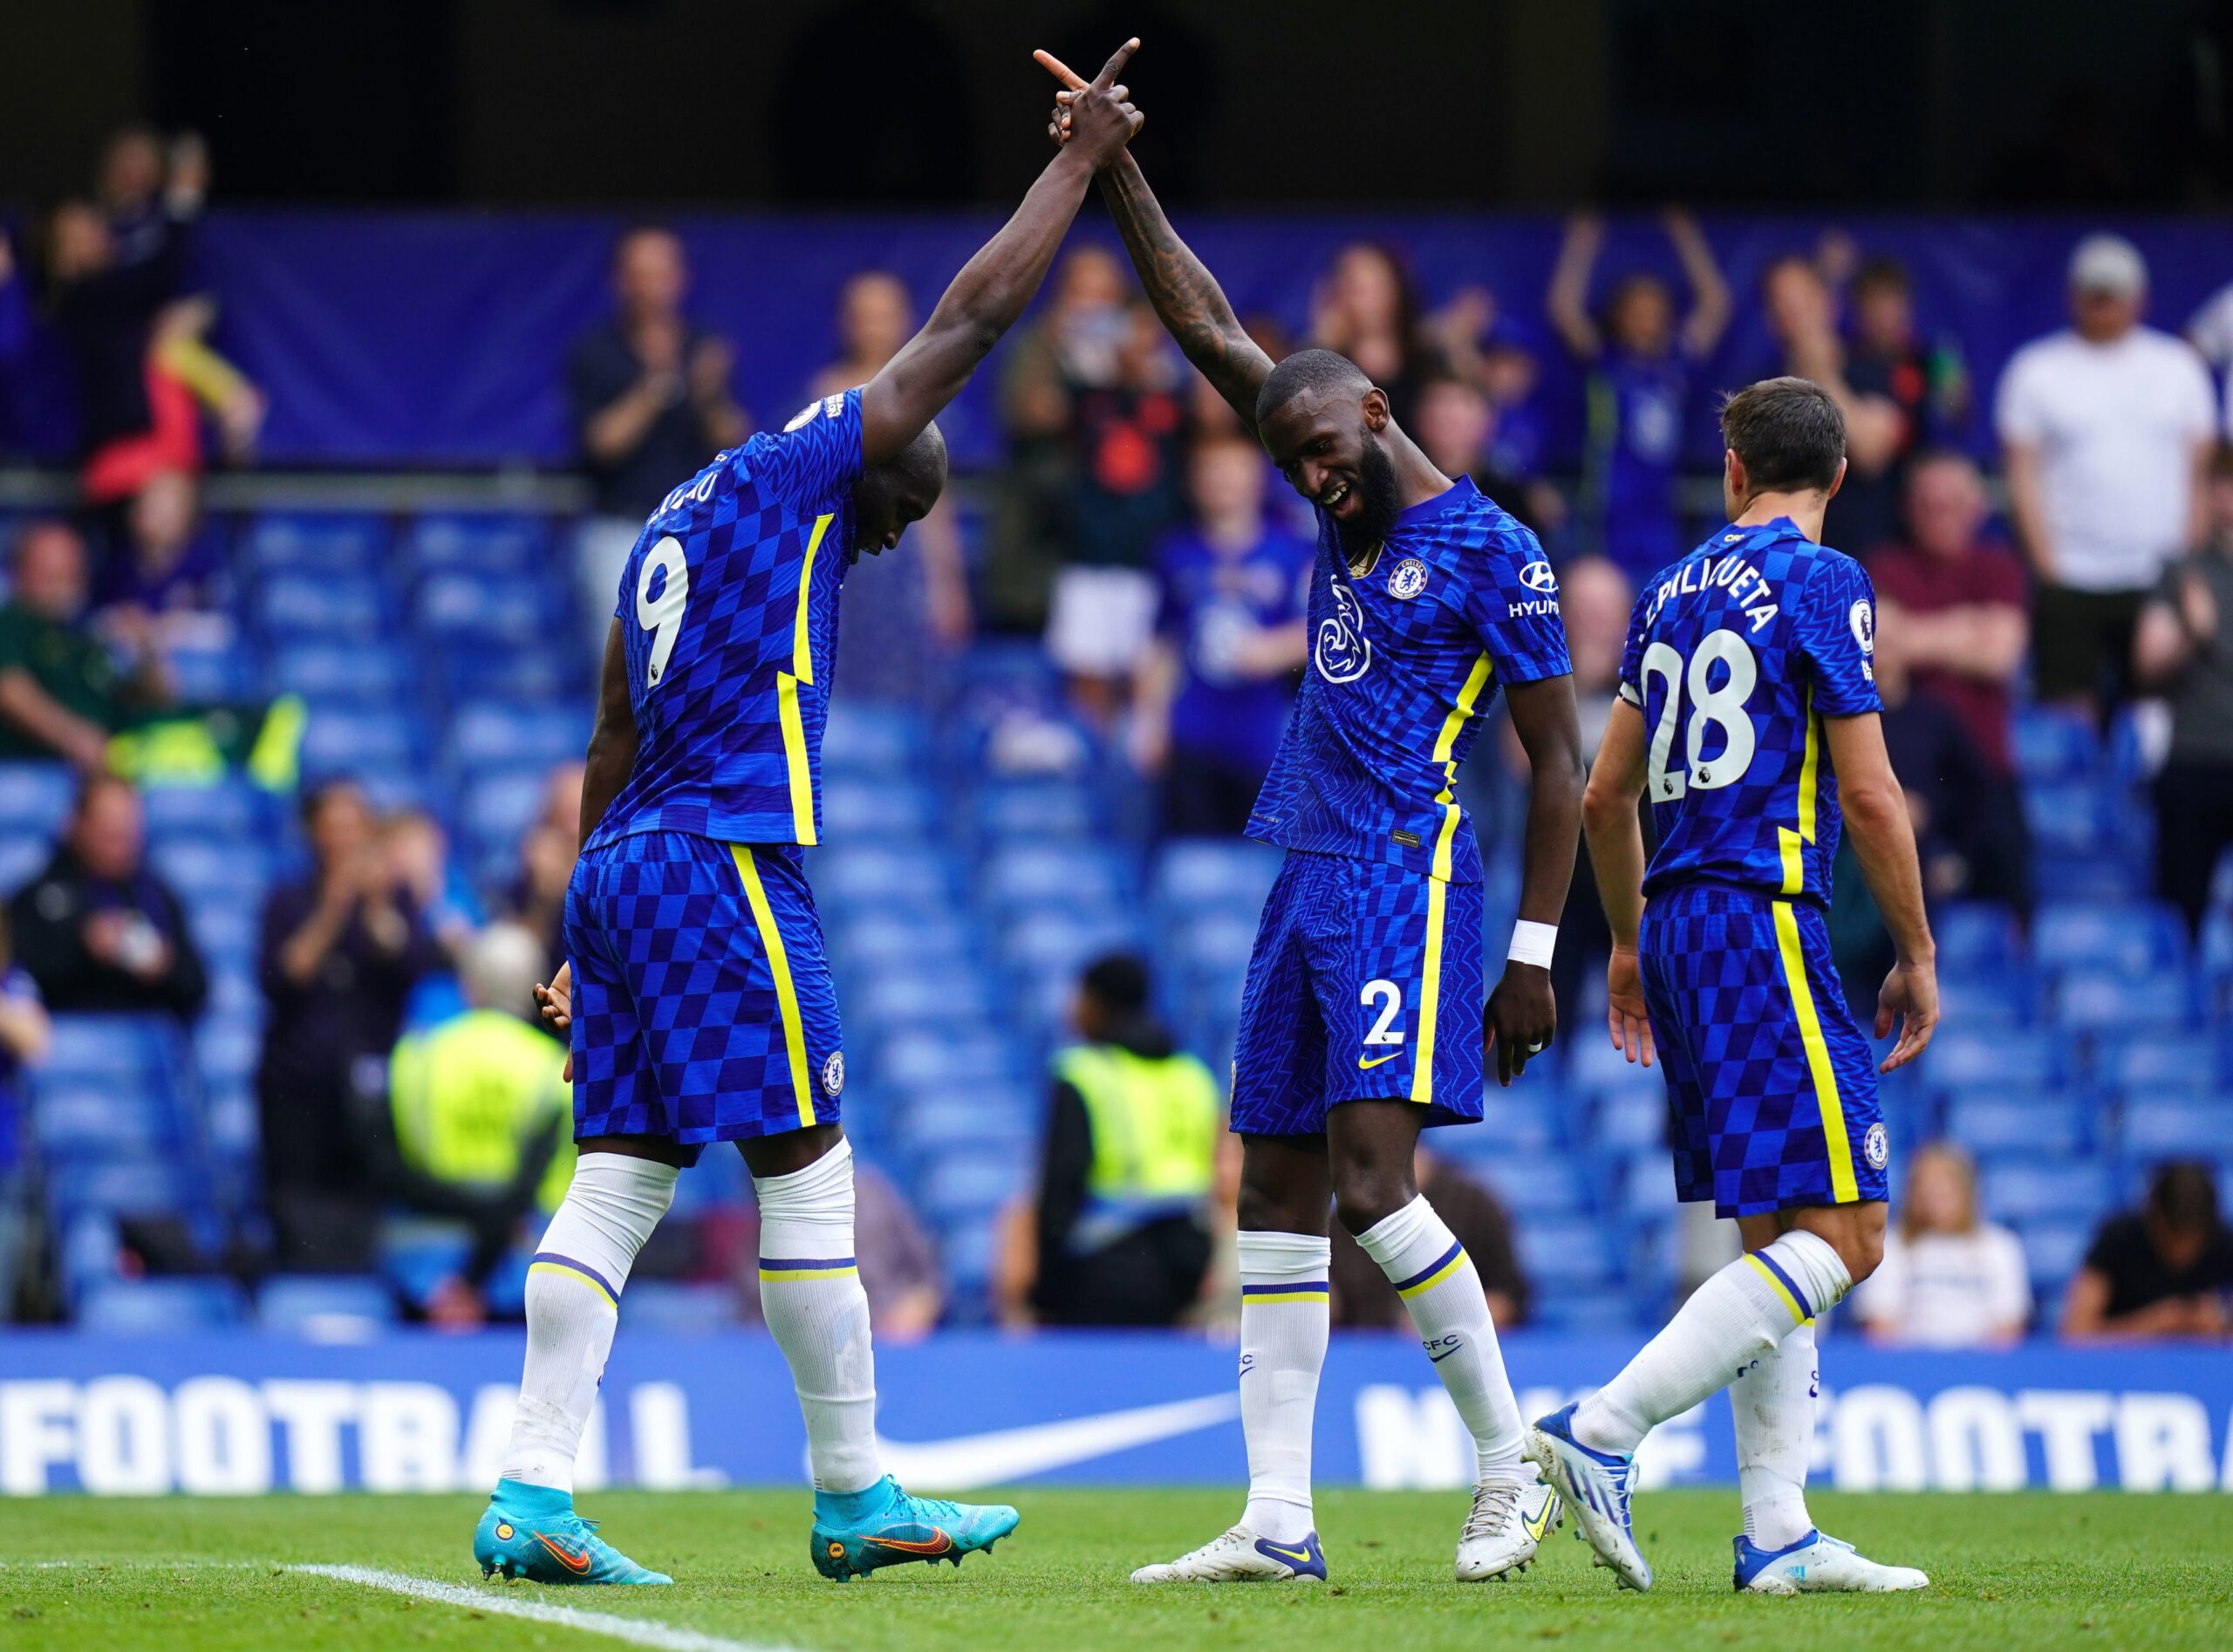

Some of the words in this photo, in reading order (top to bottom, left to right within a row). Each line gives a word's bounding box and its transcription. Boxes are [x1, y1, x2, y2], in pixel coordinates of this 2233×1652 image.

[636, 536, 689, 689] 9
[1641, 629, 1757, 803] 28
[1360, 980, 1405, 1045] 2
[1423, 1335, 1459, 1351] CFC
